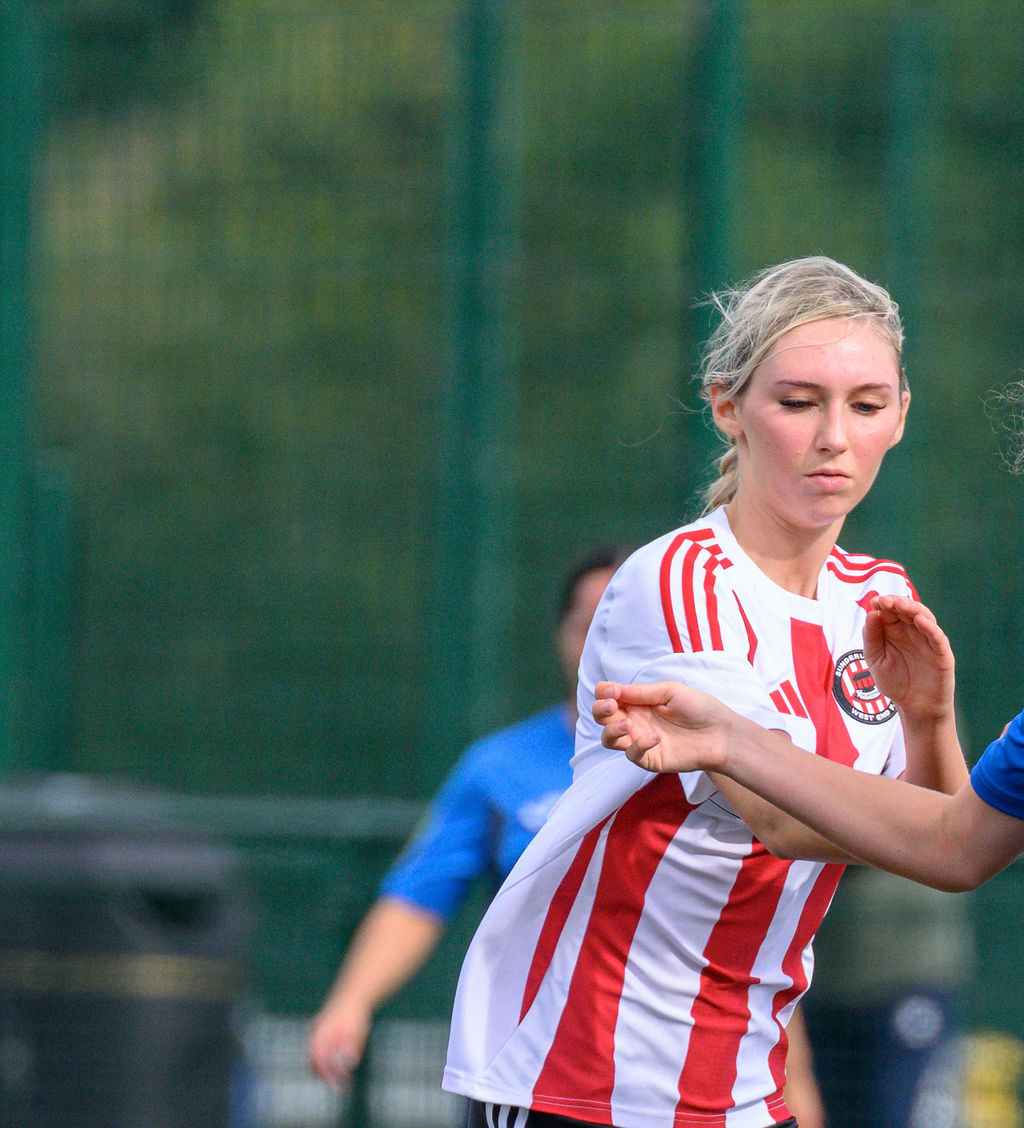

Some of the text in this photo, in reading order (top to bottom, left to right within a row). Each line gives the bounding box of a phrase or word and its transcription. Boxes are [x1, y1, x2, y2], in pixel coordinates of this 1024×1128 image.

[836, 653, 864, 677] SUNDERL
[851, 708, 874, 721] WEST
[876, 709, 891, 721] END
